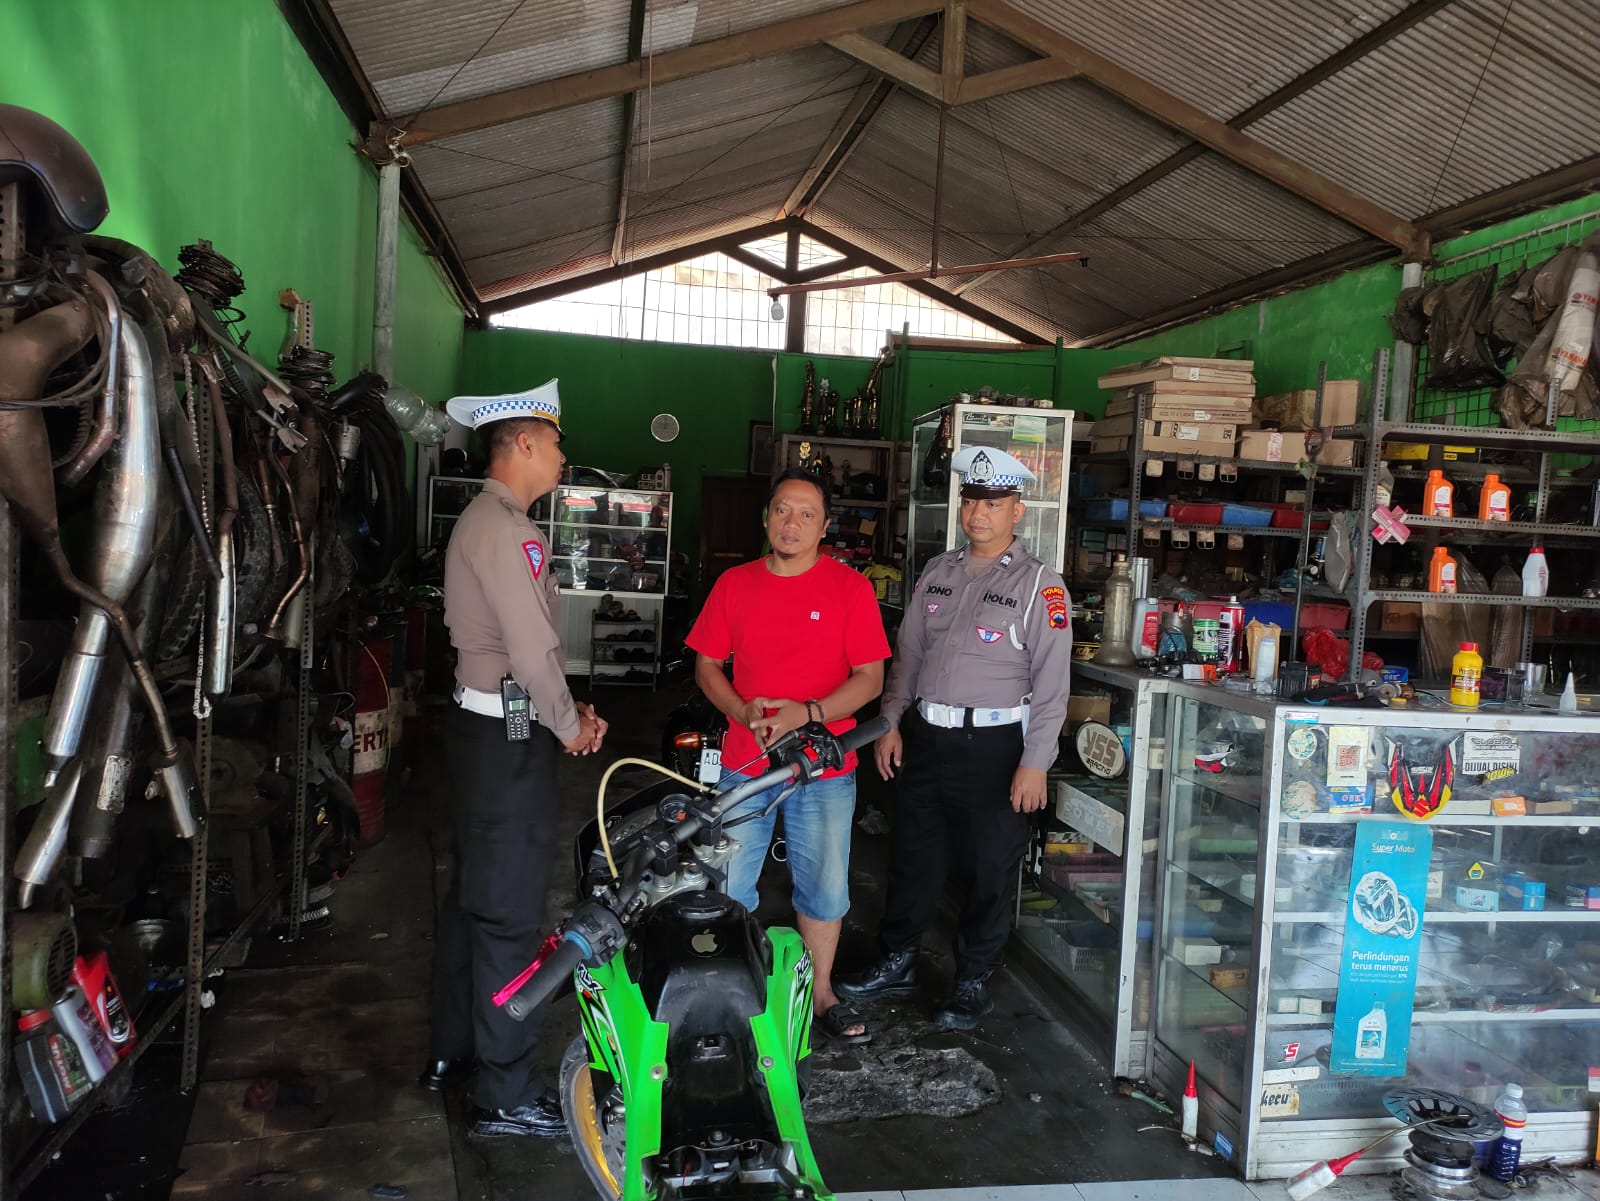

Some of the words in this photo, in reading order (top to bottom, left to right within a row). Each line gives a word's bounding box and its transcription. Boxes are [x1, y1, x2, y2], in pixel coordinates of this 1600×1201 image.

[926, 584, 953, 597] JONO
[1082, 727, 1120, 769] YSS
[1372, 842, 1394, 854] Super
[1395, 844, 1415, 853] Moto
[1351, 950, 1410, 965] Perlindungan
[1351, 961, 1372, 970] terus
[1374, 963, 1409, 972] menerus
